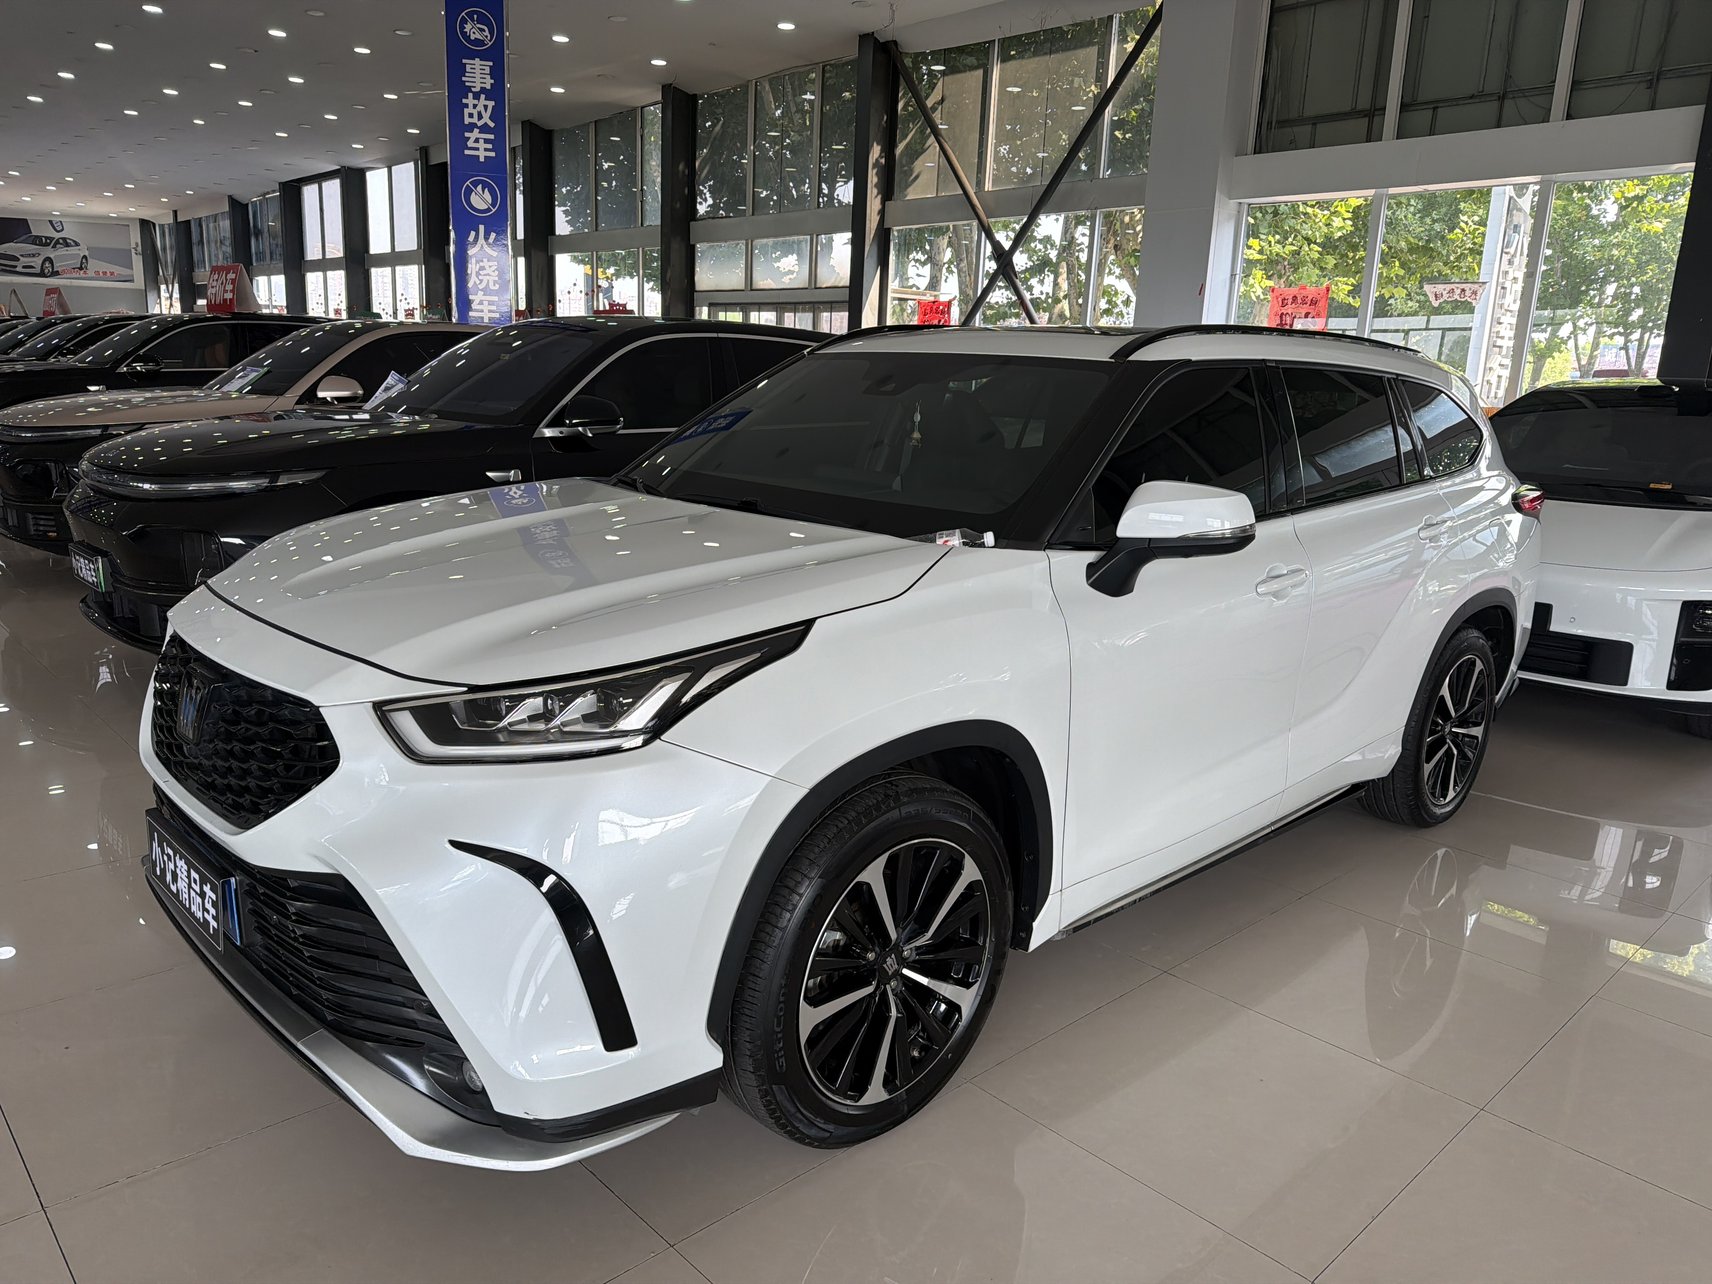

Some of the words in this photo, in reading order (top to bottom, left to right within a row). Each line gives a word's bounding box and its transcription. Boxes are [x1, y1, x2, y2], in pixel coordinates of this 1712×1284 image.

[461, 57, 496, 162] 事故车
[208, 269, 236, 305] 特价车
[466, 223, 500, 323] 火烧车
[152, 831, 218, 935] 小记精品车
